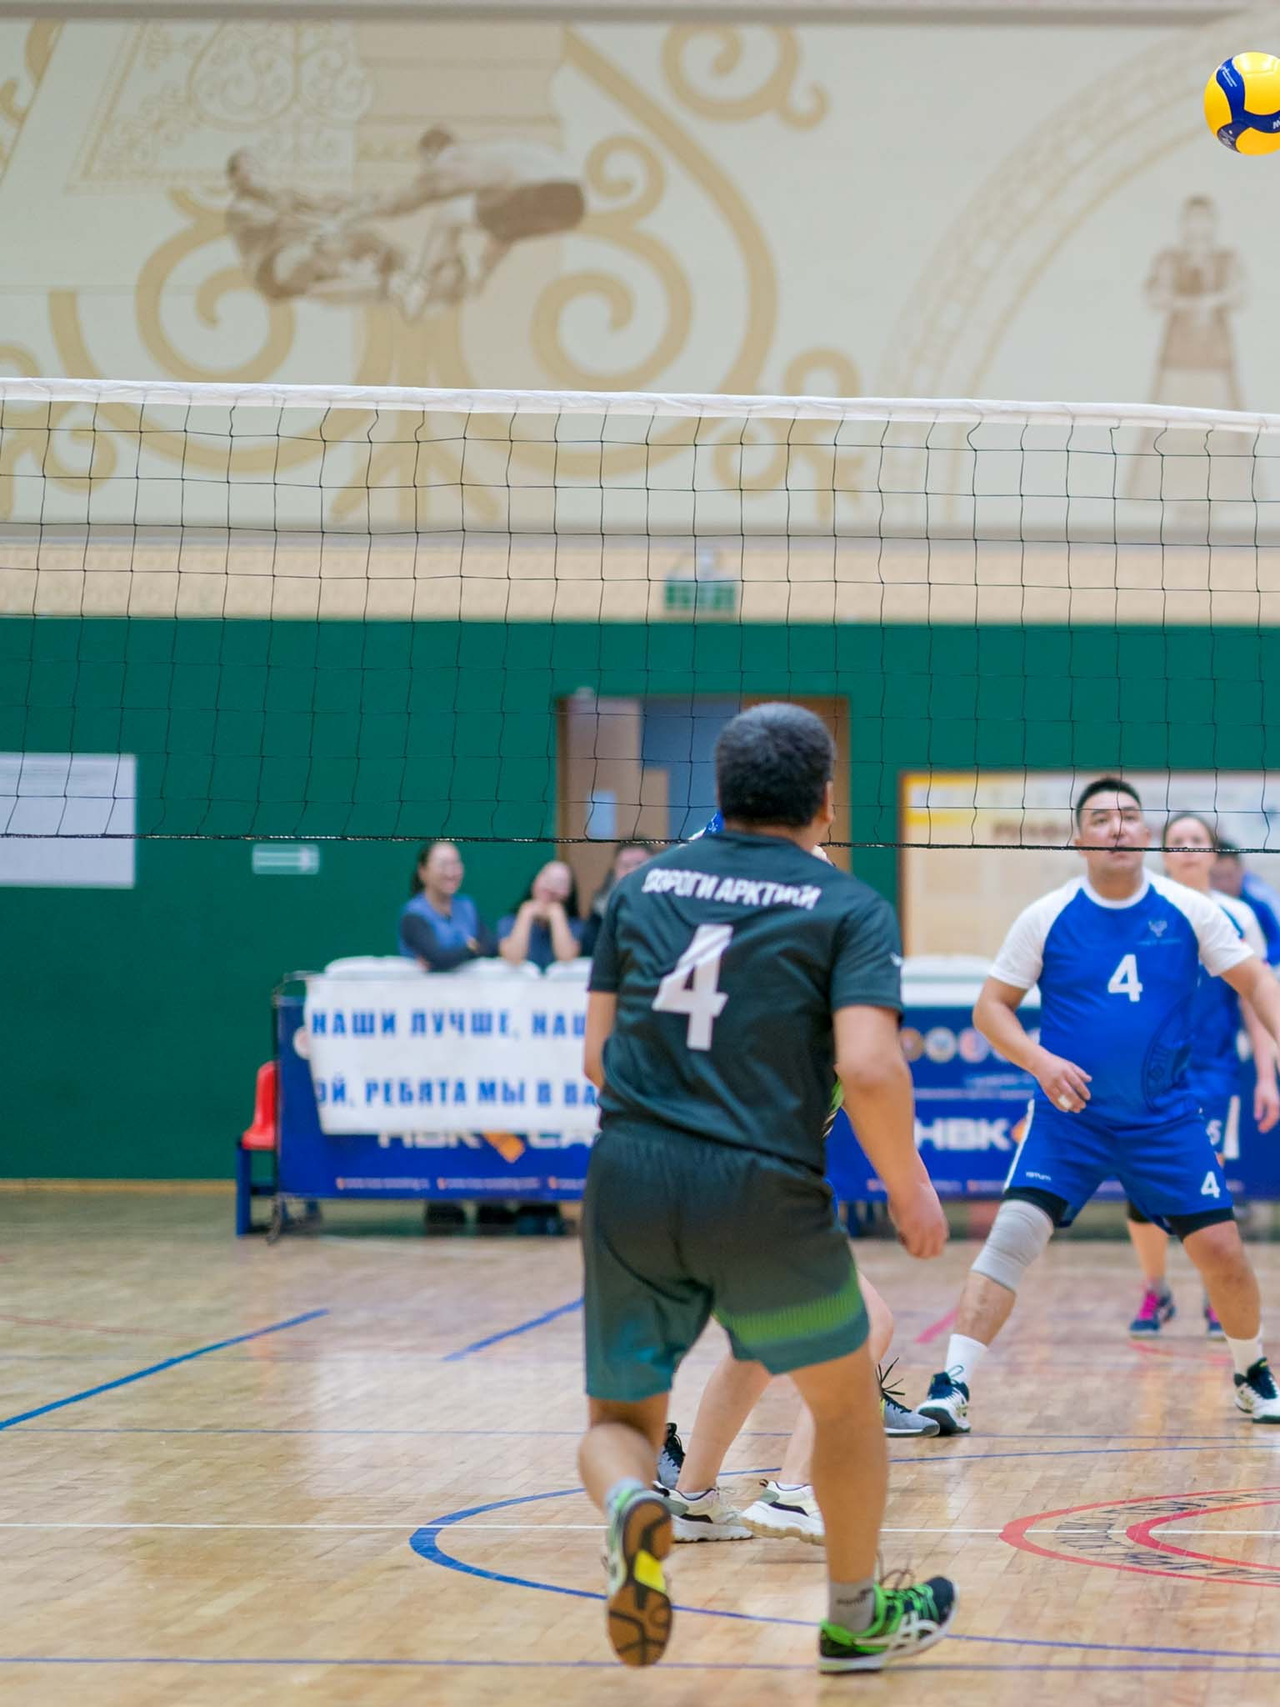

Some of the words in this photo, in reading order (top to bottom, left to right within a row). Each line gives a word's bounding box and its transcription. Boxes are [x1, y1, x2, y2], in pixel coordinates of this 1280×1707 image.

[641, 867, 719, 899] ДОРОГИ
[652, 923, 734, 1051] 4
[1108, 953, 1143, 1002] 4
[312, 1012, 396, 1036] НАШИ
[365, 1080, 466, 1105] РЕБЯТА
[478, 1081, 526, 1105] МЫ
[1200, 1171, 1221, 1199] 4
